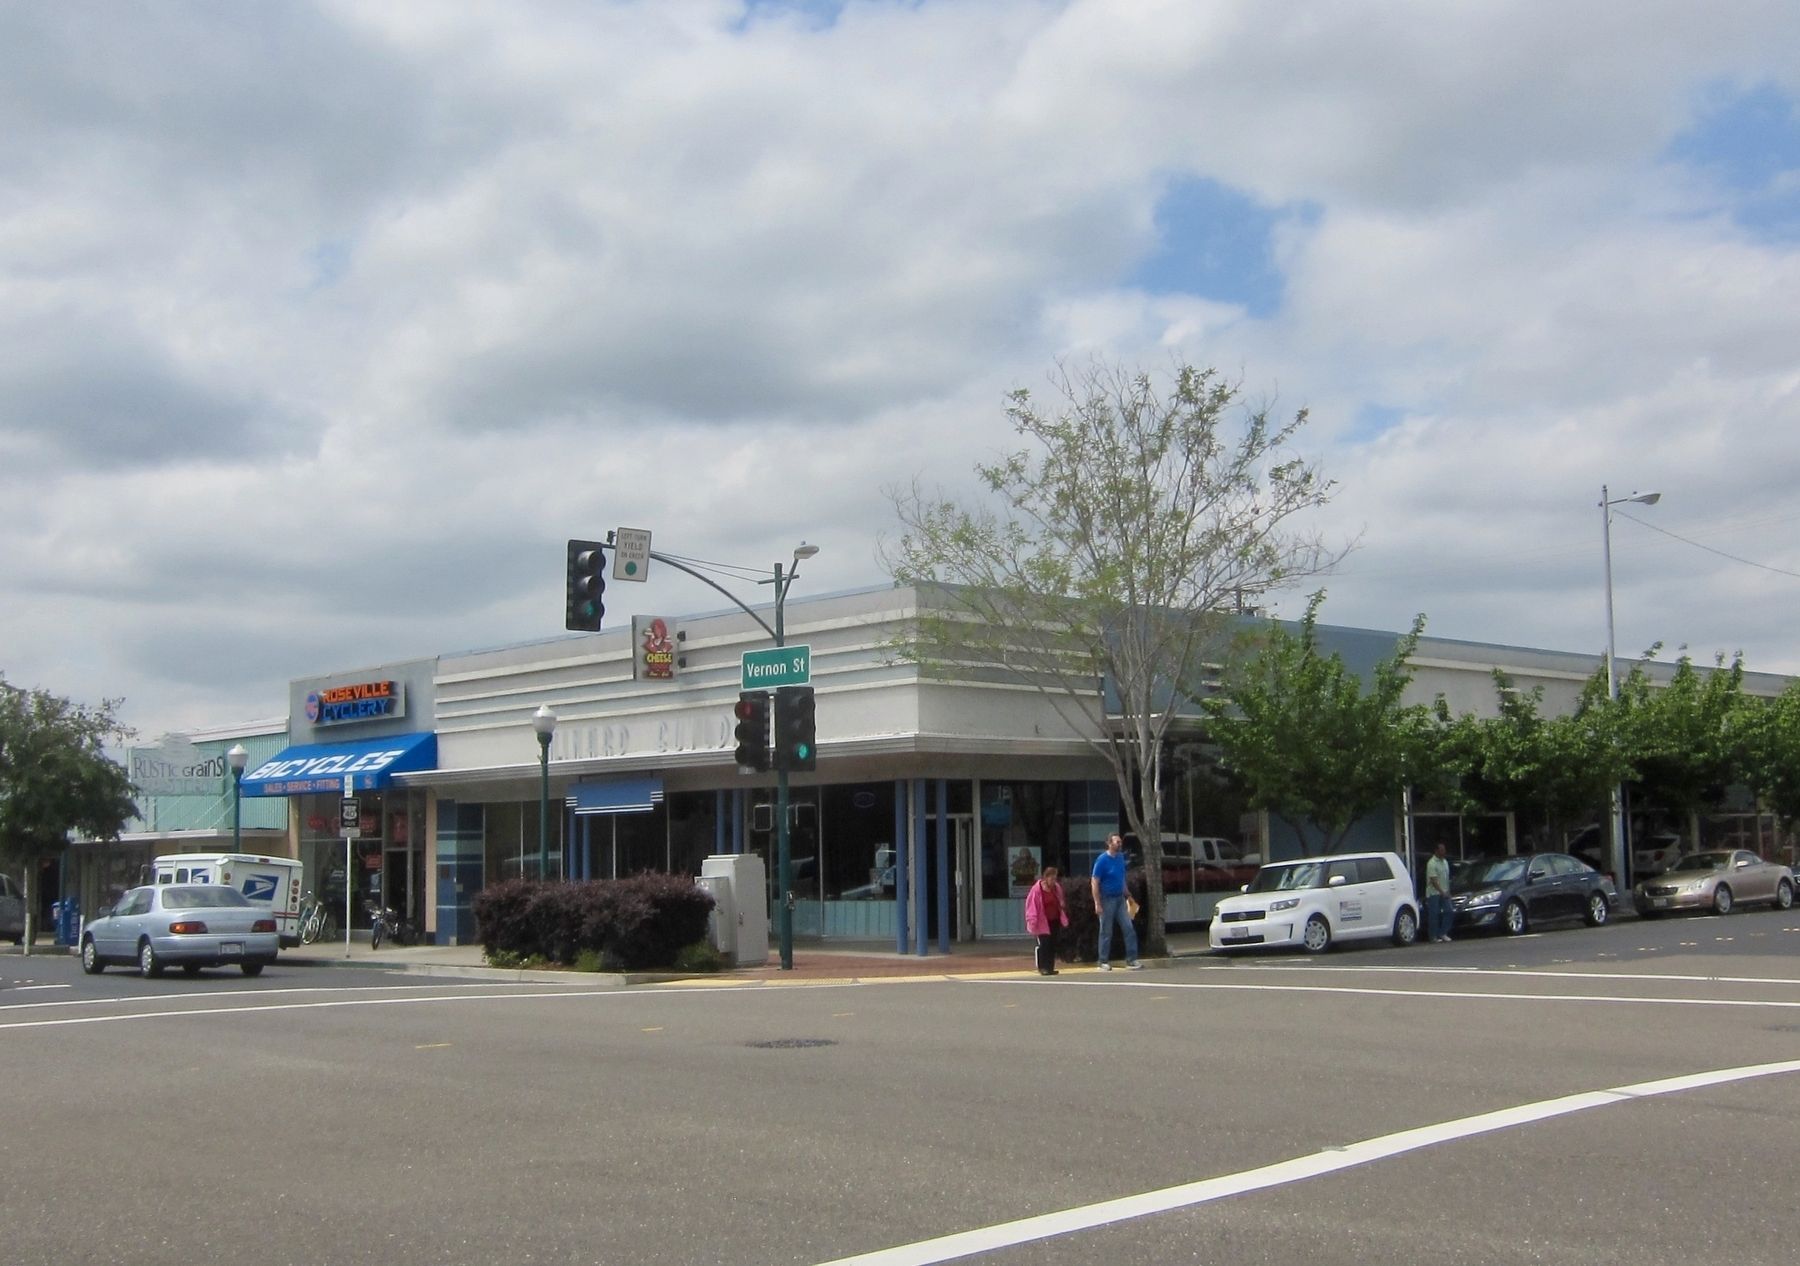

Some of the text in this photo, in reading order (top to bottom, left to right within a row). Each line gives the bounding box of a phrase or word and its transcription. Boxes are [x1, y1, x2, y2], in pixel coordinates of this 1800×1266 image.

[624, 542, 643, 551] YIELD
[747, 657, 805, 678] Vernon St
[322, 680, 390, 703] ROSEVILLE
[322, 699, 388, 721] CYCLERY
[244, 750, 406, 781] BICYCLES
[345, 810, 355, 818] 40
